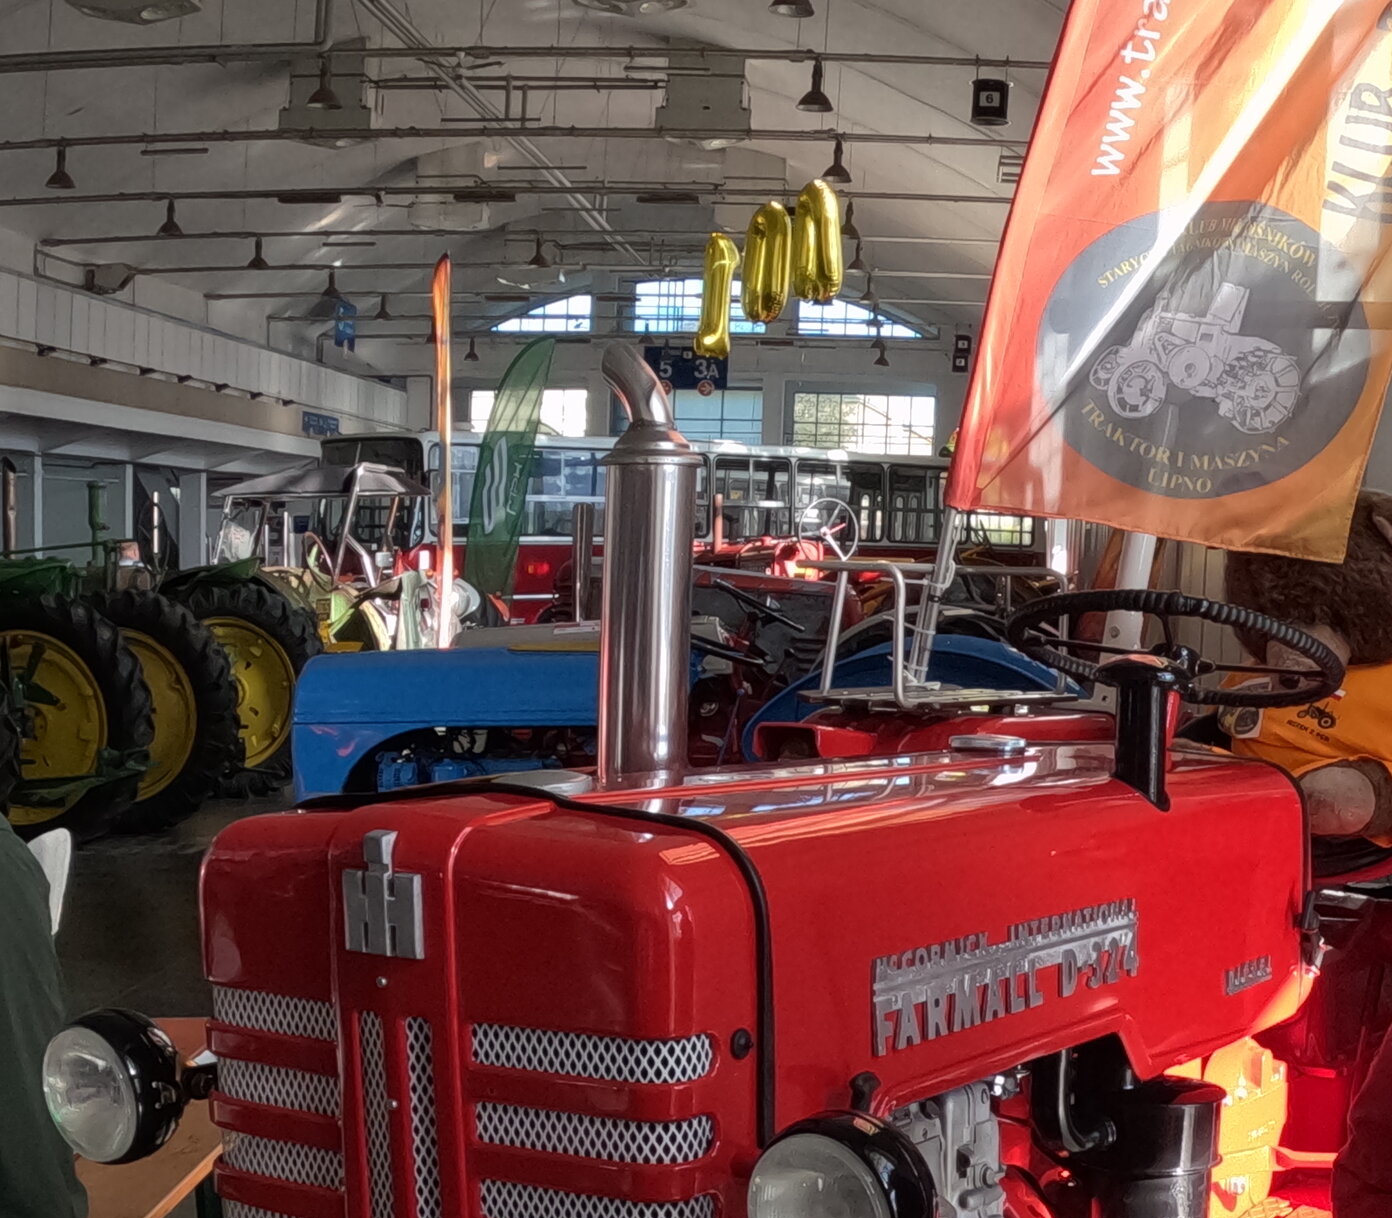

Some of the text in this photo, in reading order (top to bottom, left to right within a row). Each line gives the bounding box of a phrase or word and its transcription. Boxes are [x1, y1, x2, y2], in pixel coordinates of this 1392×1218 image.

[1097, 251, 1152, 288] STARYC
[659, 360, 673, 378] 5
[1081, 399, 1291, 471] TRAKTOR I MASZYNA
[1147, 468, 1212, 493] LIPNO
[872, 967, 1044, 1057] FARMALL
